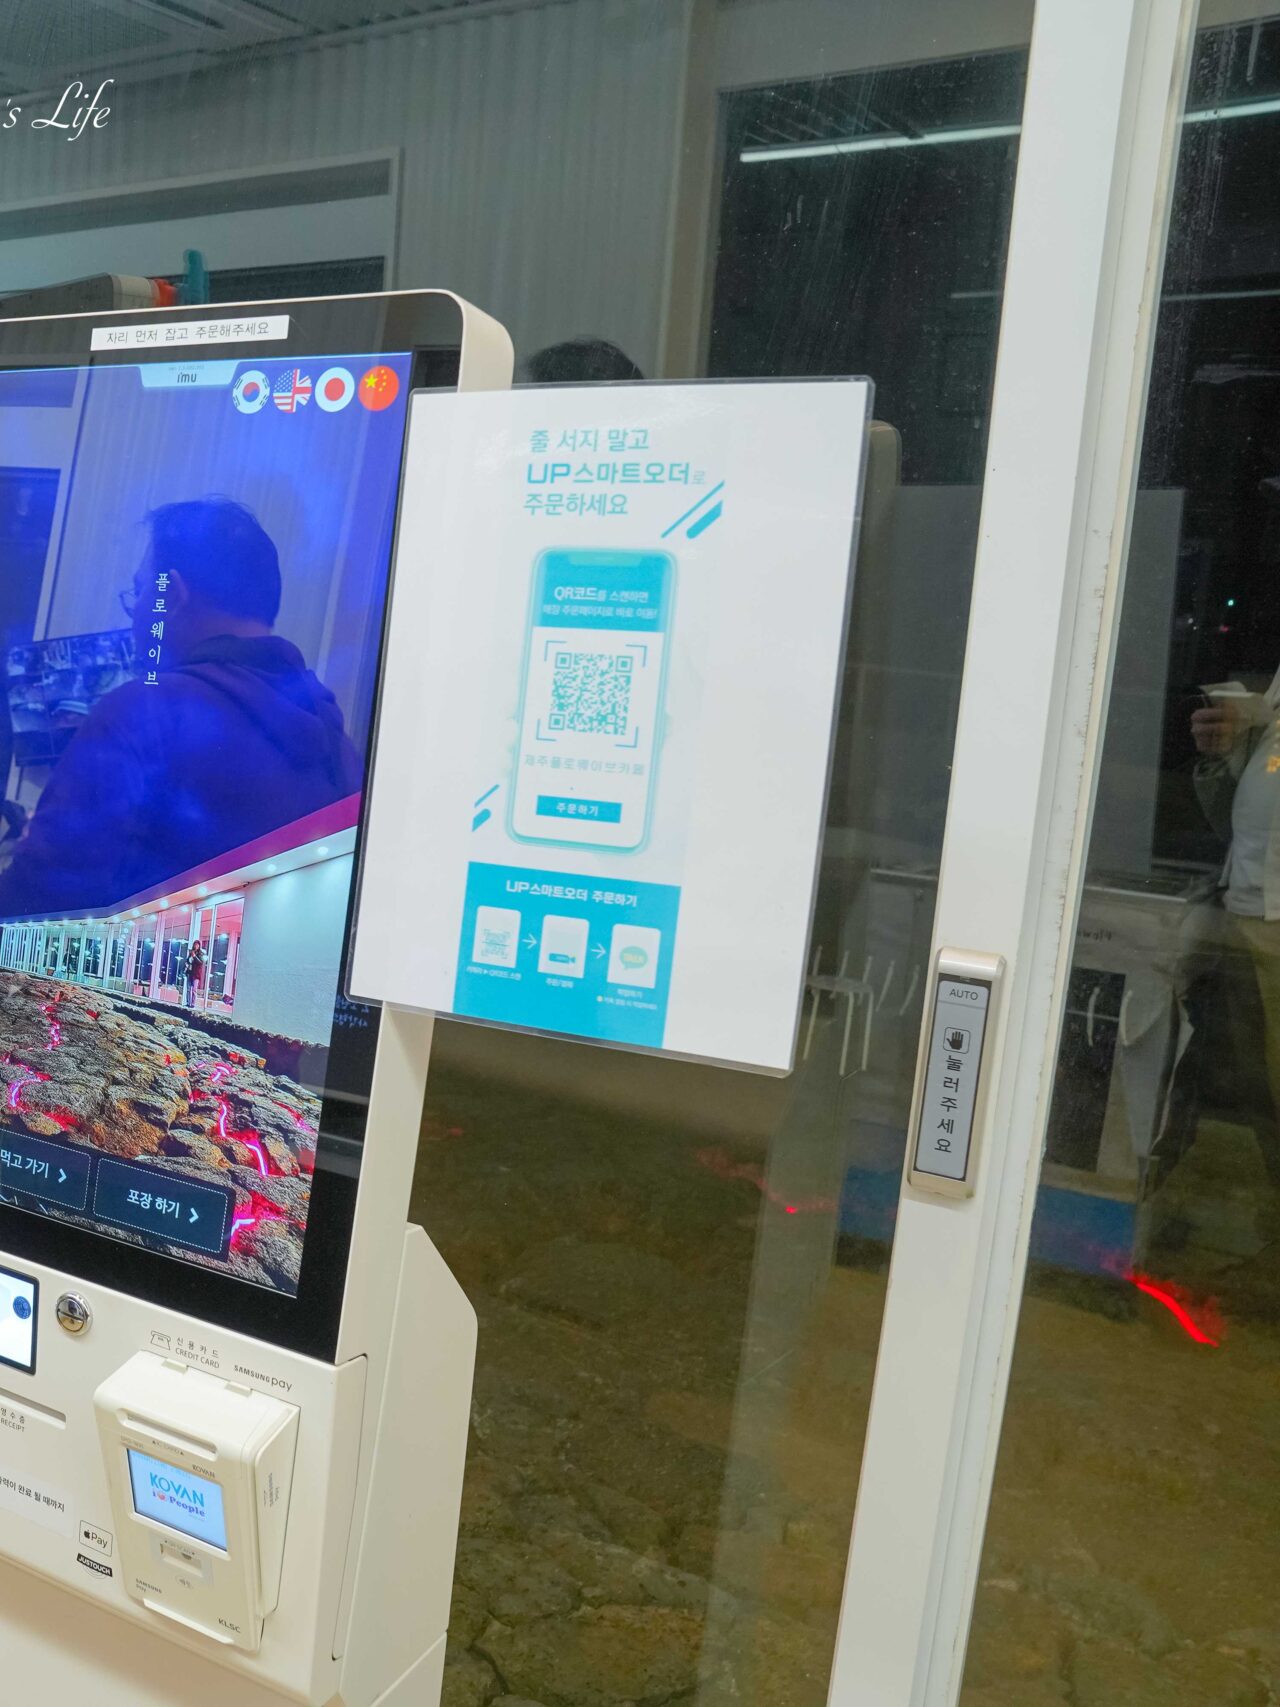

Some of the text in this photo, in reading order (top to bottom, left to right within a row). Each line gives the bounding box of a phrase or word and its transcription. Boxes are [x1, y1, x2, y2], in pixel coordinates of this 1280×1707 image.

[106, 321, 270, 344] 자리 먼저 잡고 주문해주세요
[529, 429, 649, 453] 줄 서지 말고
[523, 493, 629, 516] 주문하세요
[144, 573, 171, 685] 플로웨이브
[556, 801, 599, 817] 주문하기
[505, 879, 638, 907] UP스마트오더 주문하기
[949, 988, 979, 1001] AUTO
[935, 1055, 964, 1153] 눌러주세요
[0, 1148, 49, 1179] 먹고 가기
[126, 1188, 180, 1218] 포장 하기
[175, 1347, 220, 1369] CREDIT CARD
[234, 1364, 293, 1393] SAMSUNG pay
[0, 1417, 26, 1433] RECEIPT
[149, 1471, 205, 1508] KOVAN
[169, 1494, 207, 1518] People
[78, 1555, 112, 1576] JUSTOUCH
